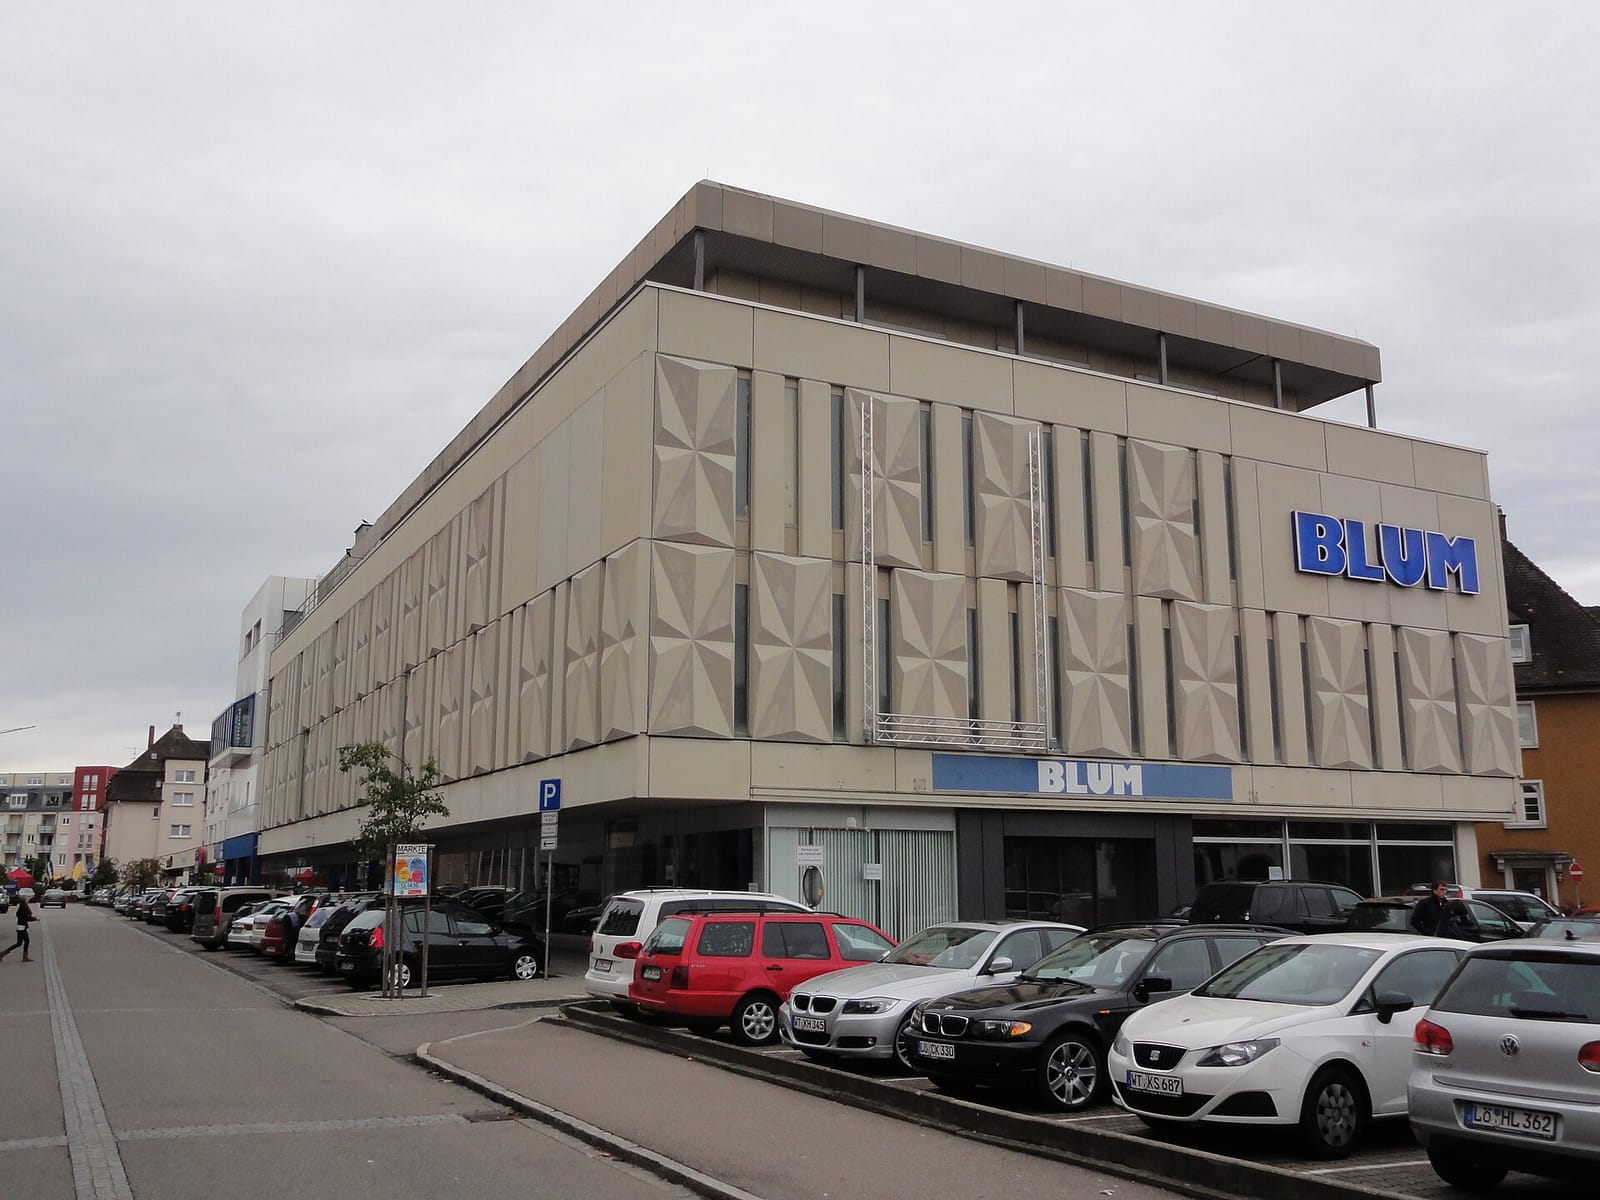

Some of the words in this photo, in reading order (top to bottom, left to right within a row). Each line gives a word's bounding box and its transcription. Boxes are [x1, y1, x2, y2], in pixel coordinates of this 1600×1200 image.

[1291, 510, 1480, 595] BLUM
[1038, 760, 1143, 796] BLUM
[543, 783, 556, 808] P
[812, 1020, 824, 1031] 345
[940, 1045, 954, 1057] 330
[1132, 1073, 1142, 1087] WT
[1147, 1075, 1160, 1090] KS
[1162, 1078, 1180, 1093] 687
[1473, 1105, 1492, 1123] LÖ
[1501, 1111, 1519, 1127] HL
[1523, 1112, 1552, 1132] 362
